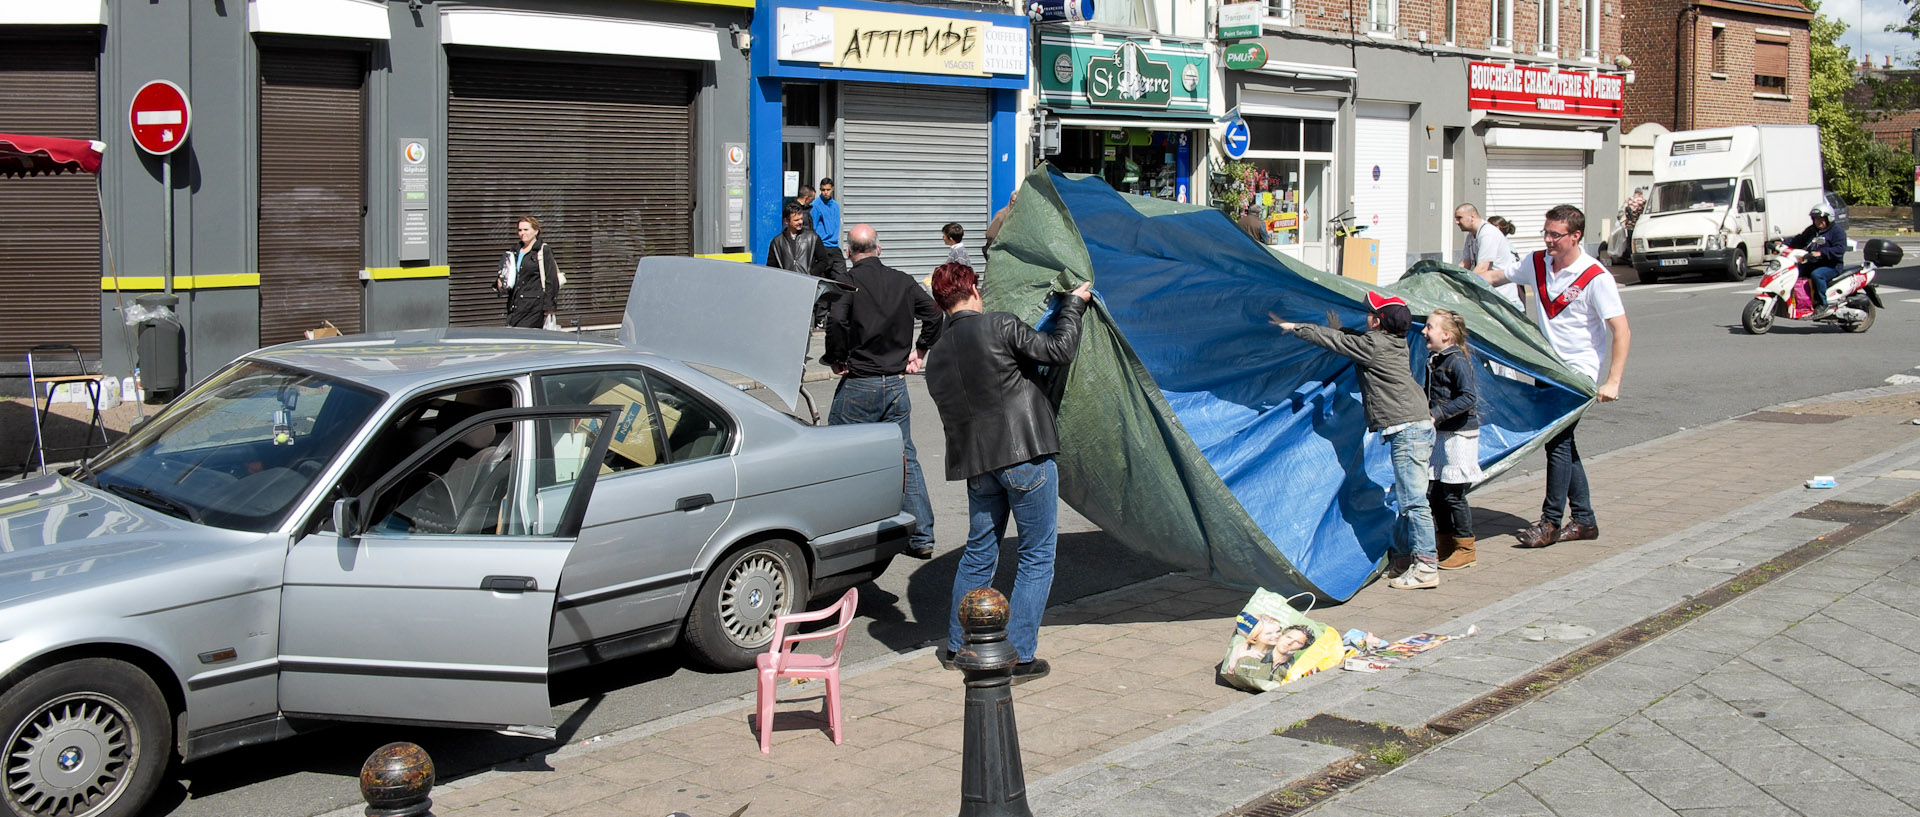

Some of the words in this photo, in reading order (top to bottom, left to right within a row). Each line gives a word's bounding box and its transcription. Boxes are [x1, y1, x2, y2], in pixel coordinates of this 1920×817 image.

[985, 30, 1024, 42] COIFFEUR
[841, 22, 977, 67] ATTITUDE
[985, 44, 1024, 56] MIXTE
[1227, 52, 1248, 62] PMU
[944, 60, 974, 71] VISAGISTE
[985, 58, 1024, 70] STYLISTE
[1093, 67, 1113, 97] St
[1471, 65, 1523, 93] BOUCHERIE
[1524, 70, 1582, 97] CHARCUTERIE
[1593, 77, 1621, 100] PIERRE
[1536, 98, 1565, 111] TRAITEUR
[621, 412, 635, 435] NEXT
